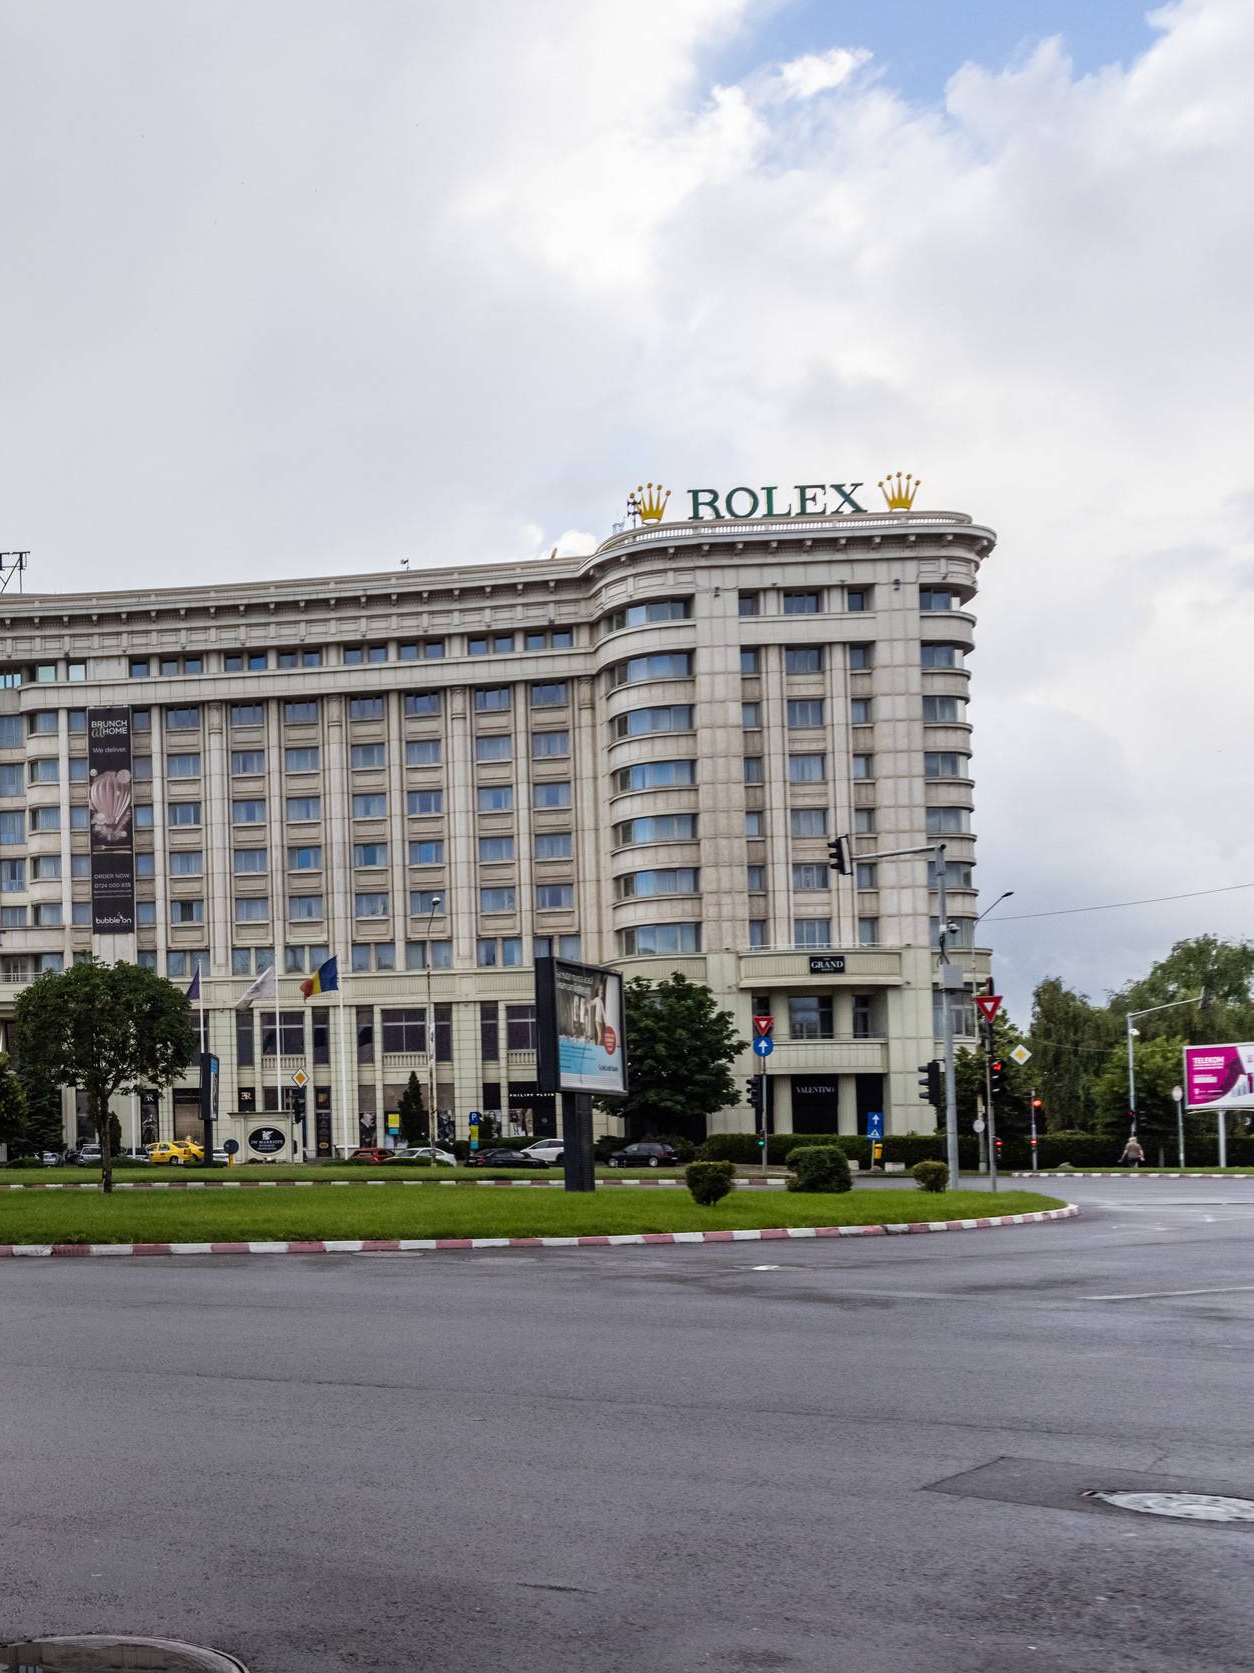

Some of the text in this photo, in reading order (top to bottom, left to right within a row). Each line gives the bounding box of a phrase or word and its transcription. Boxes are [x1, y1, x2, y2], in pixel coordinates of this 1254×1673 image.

[687, 482, 868, 520] ROLEX
[91, 720, 128, 728] BRUNCH
[103, 727, 128, 735] HOME
[810, 960, 844, 969] GRAND
[796, 1086, 835, 1094] VALENTINO
